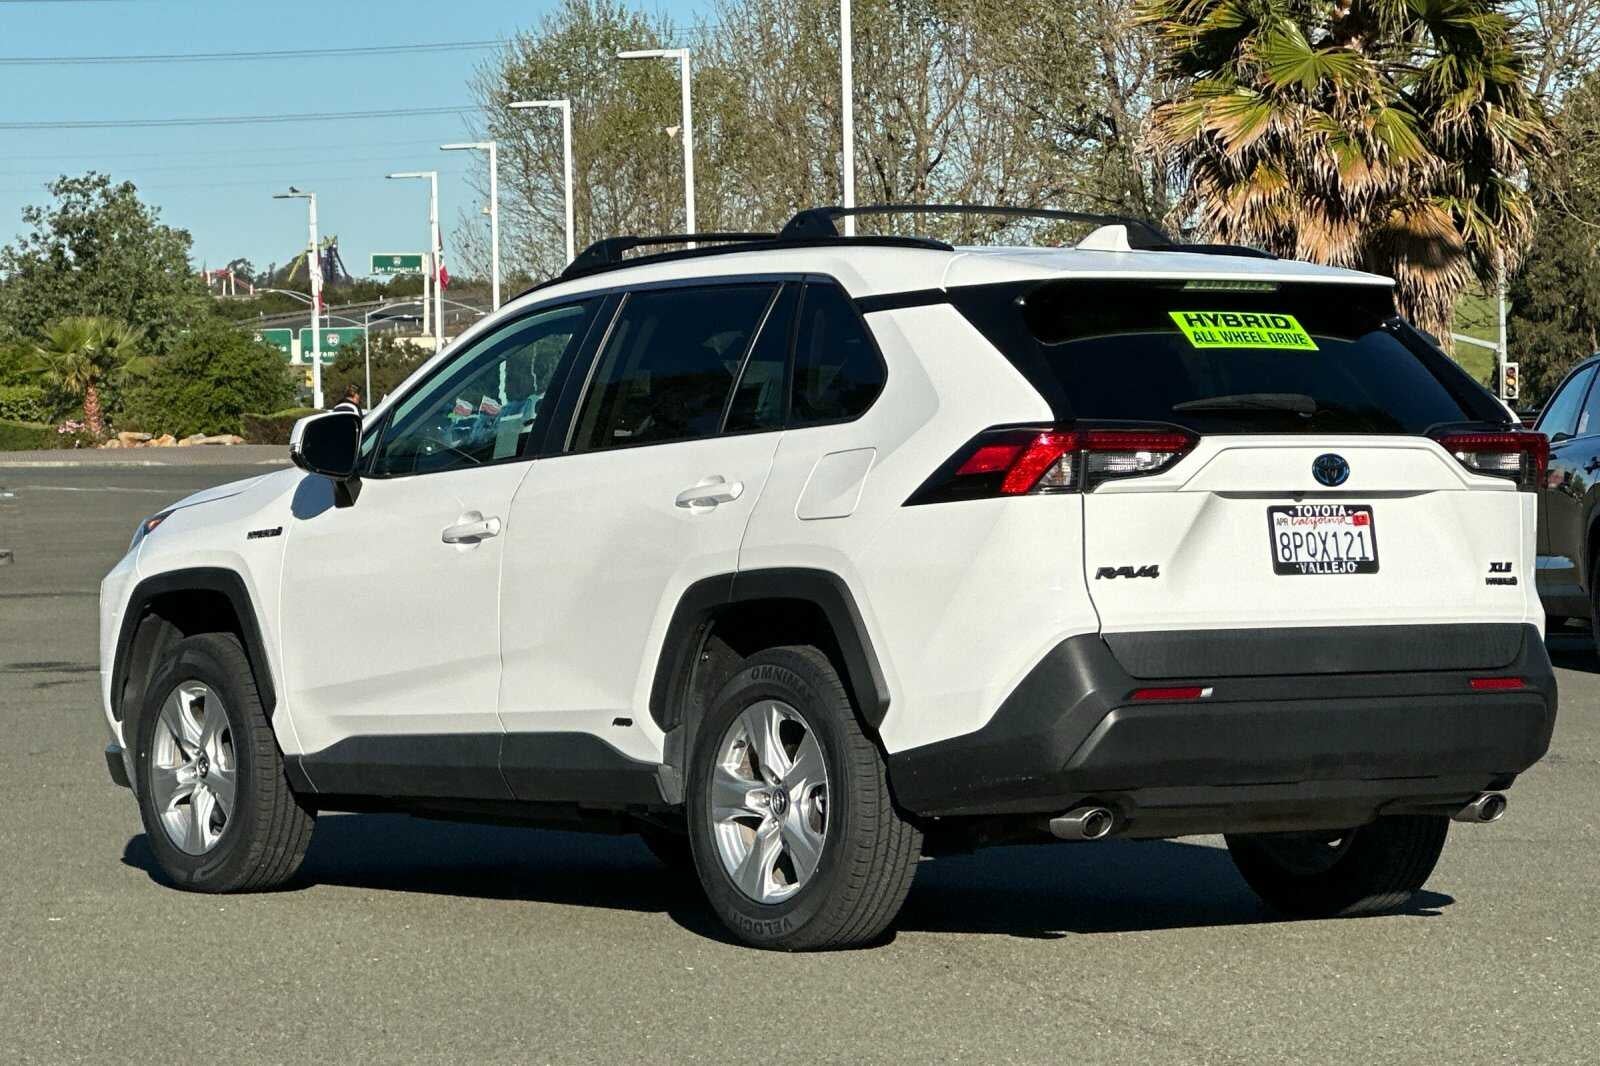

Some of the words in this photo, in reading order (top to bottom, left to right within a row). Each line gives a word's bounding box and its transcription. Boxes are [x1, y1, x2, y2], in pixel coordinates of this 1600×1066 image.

[1182, 313, 1292, 330] HYBRID
[1192, 331, 1218, 343] ALL
[1219, 331, 1267, 344] WHEEL
[1268, 333, 1308, 345] DRIVE
[1296, 505, 1347, 516] TOYOTA
[1280, 531, 1369, 562] 8PQX121
[1095, 564, 1160, 580] RAV4
[1299, 561, 1357, 573] VALLEJO
[1488, 561, 1512, 573] XLE
